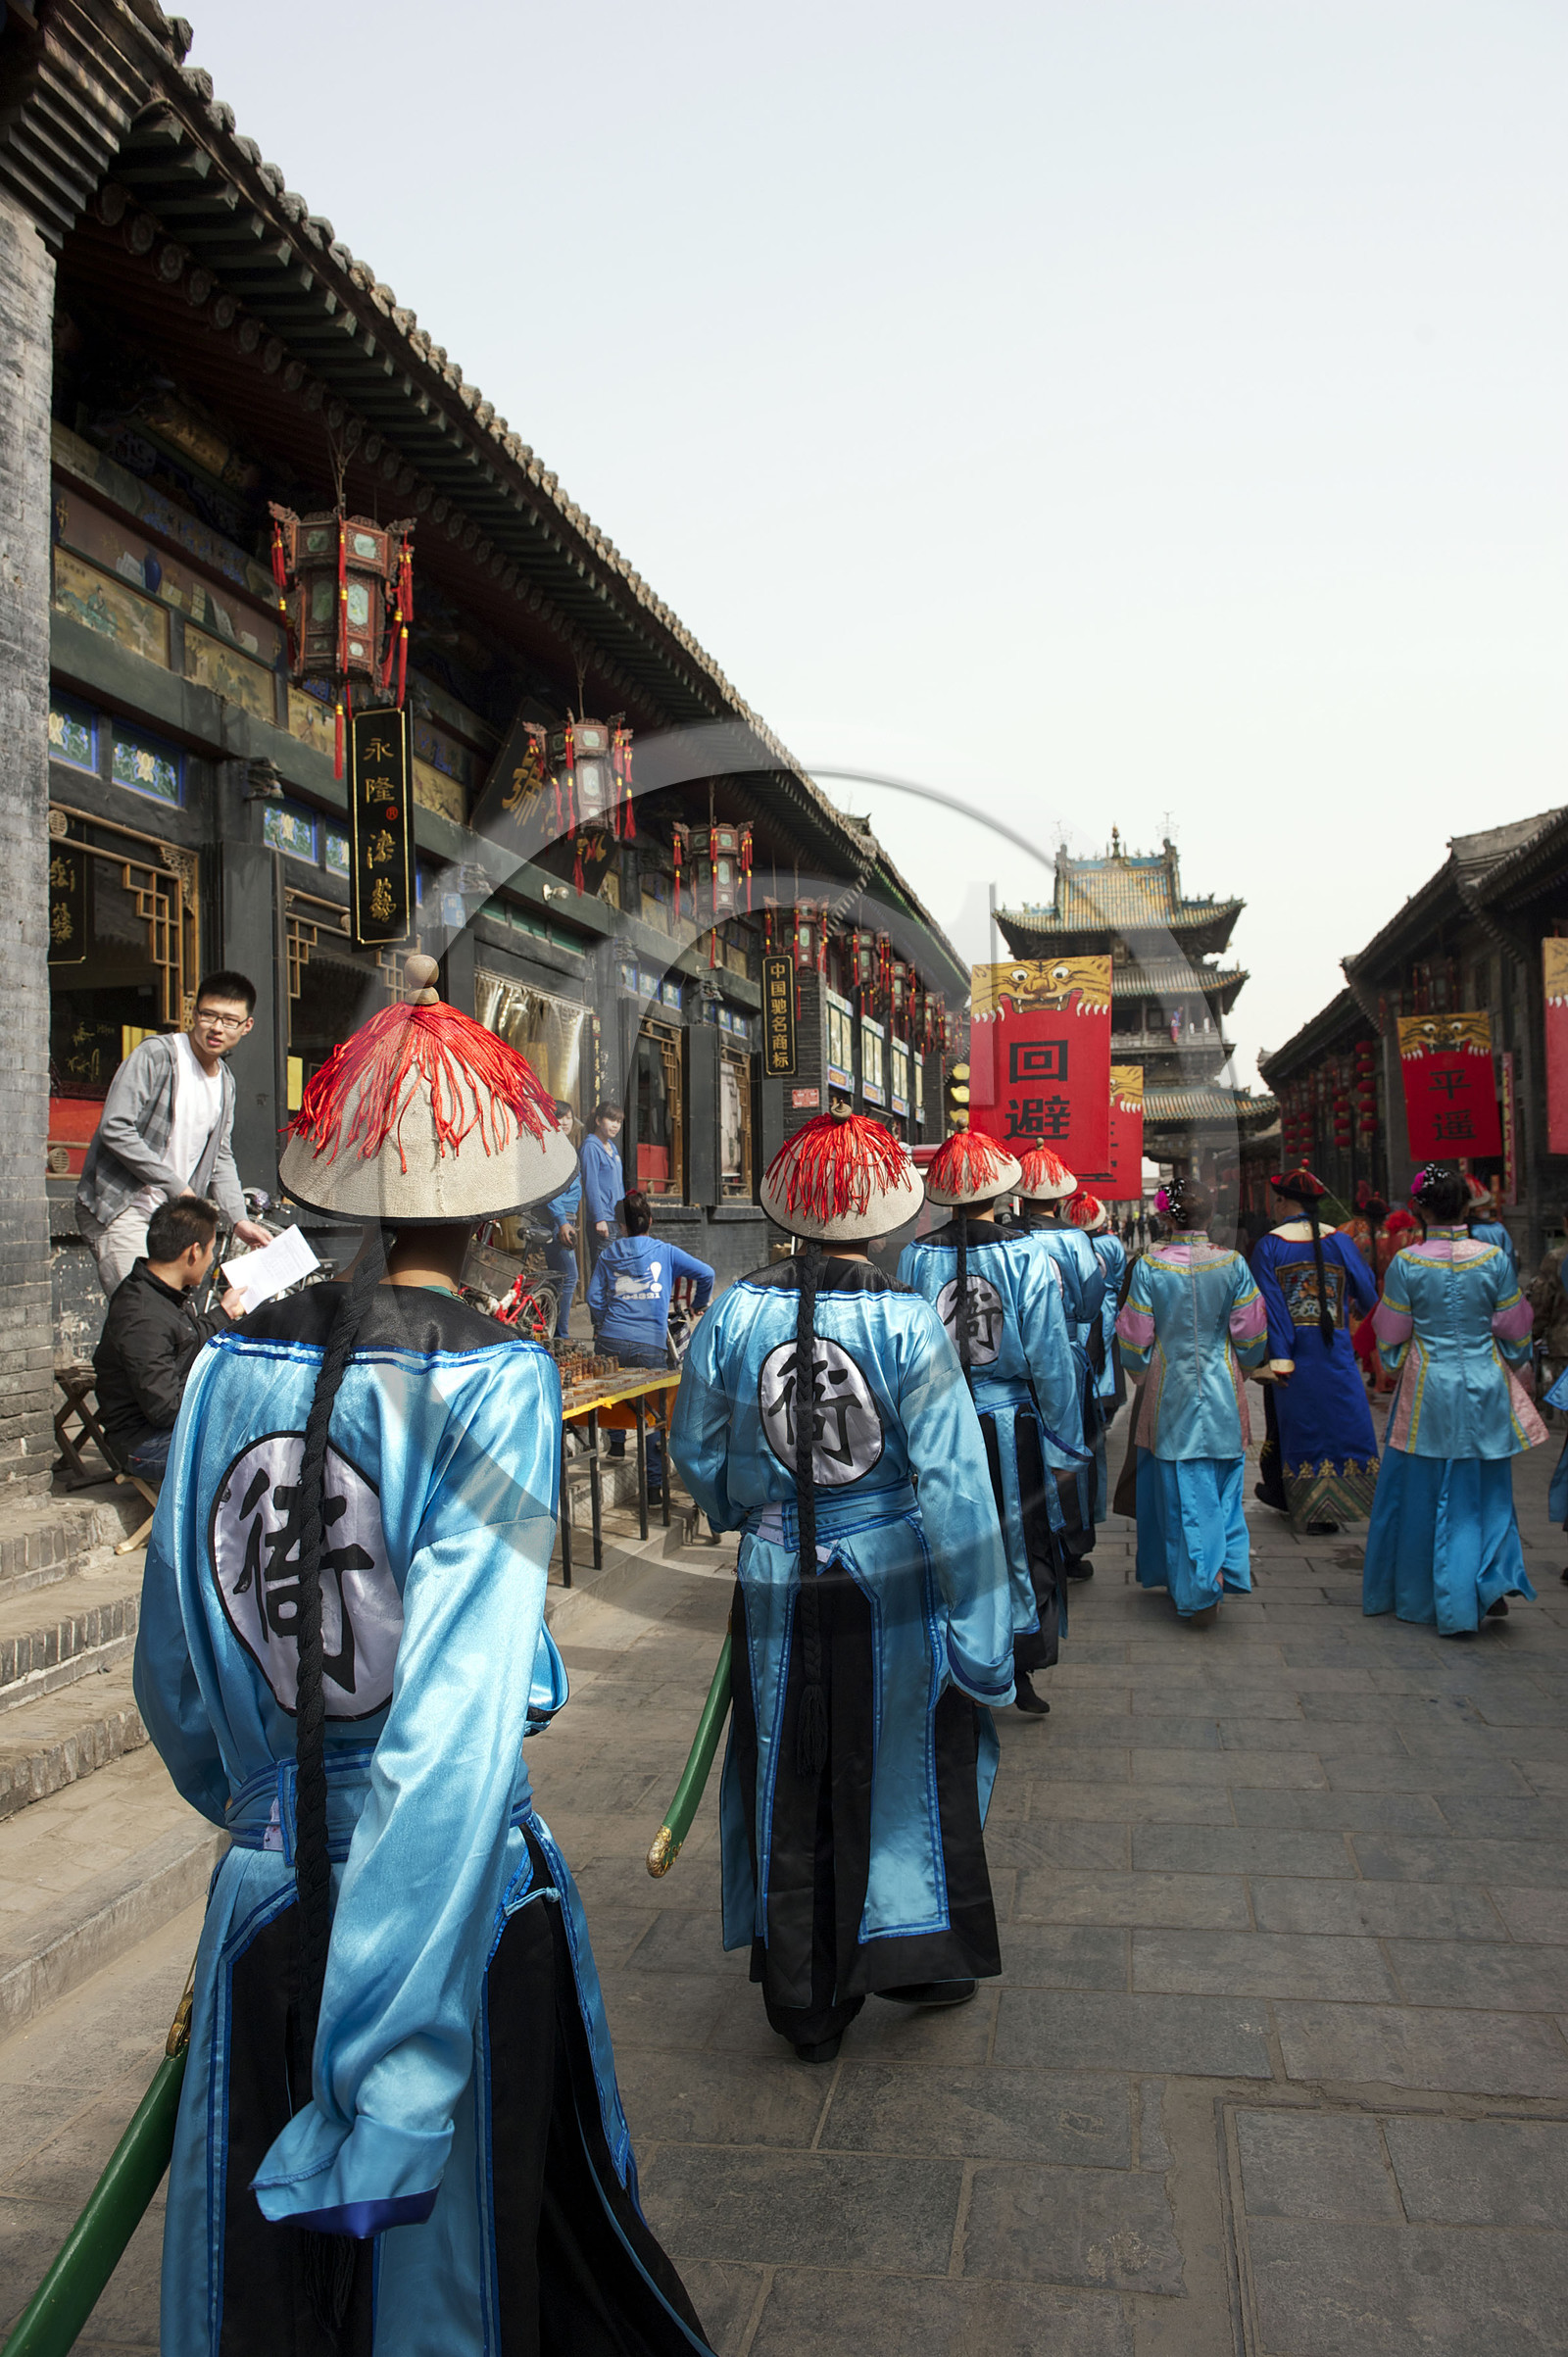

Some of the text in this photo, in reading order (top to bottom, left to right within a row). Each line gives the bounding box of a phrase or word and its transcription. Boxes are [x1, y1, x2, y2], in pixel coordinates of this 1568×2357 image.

[770, 962, 789, 1068] 中国驰名商标
[1004, 1040, 1070, 1141] 回避
[1428, 1069, 1477, 1141] 平遥
